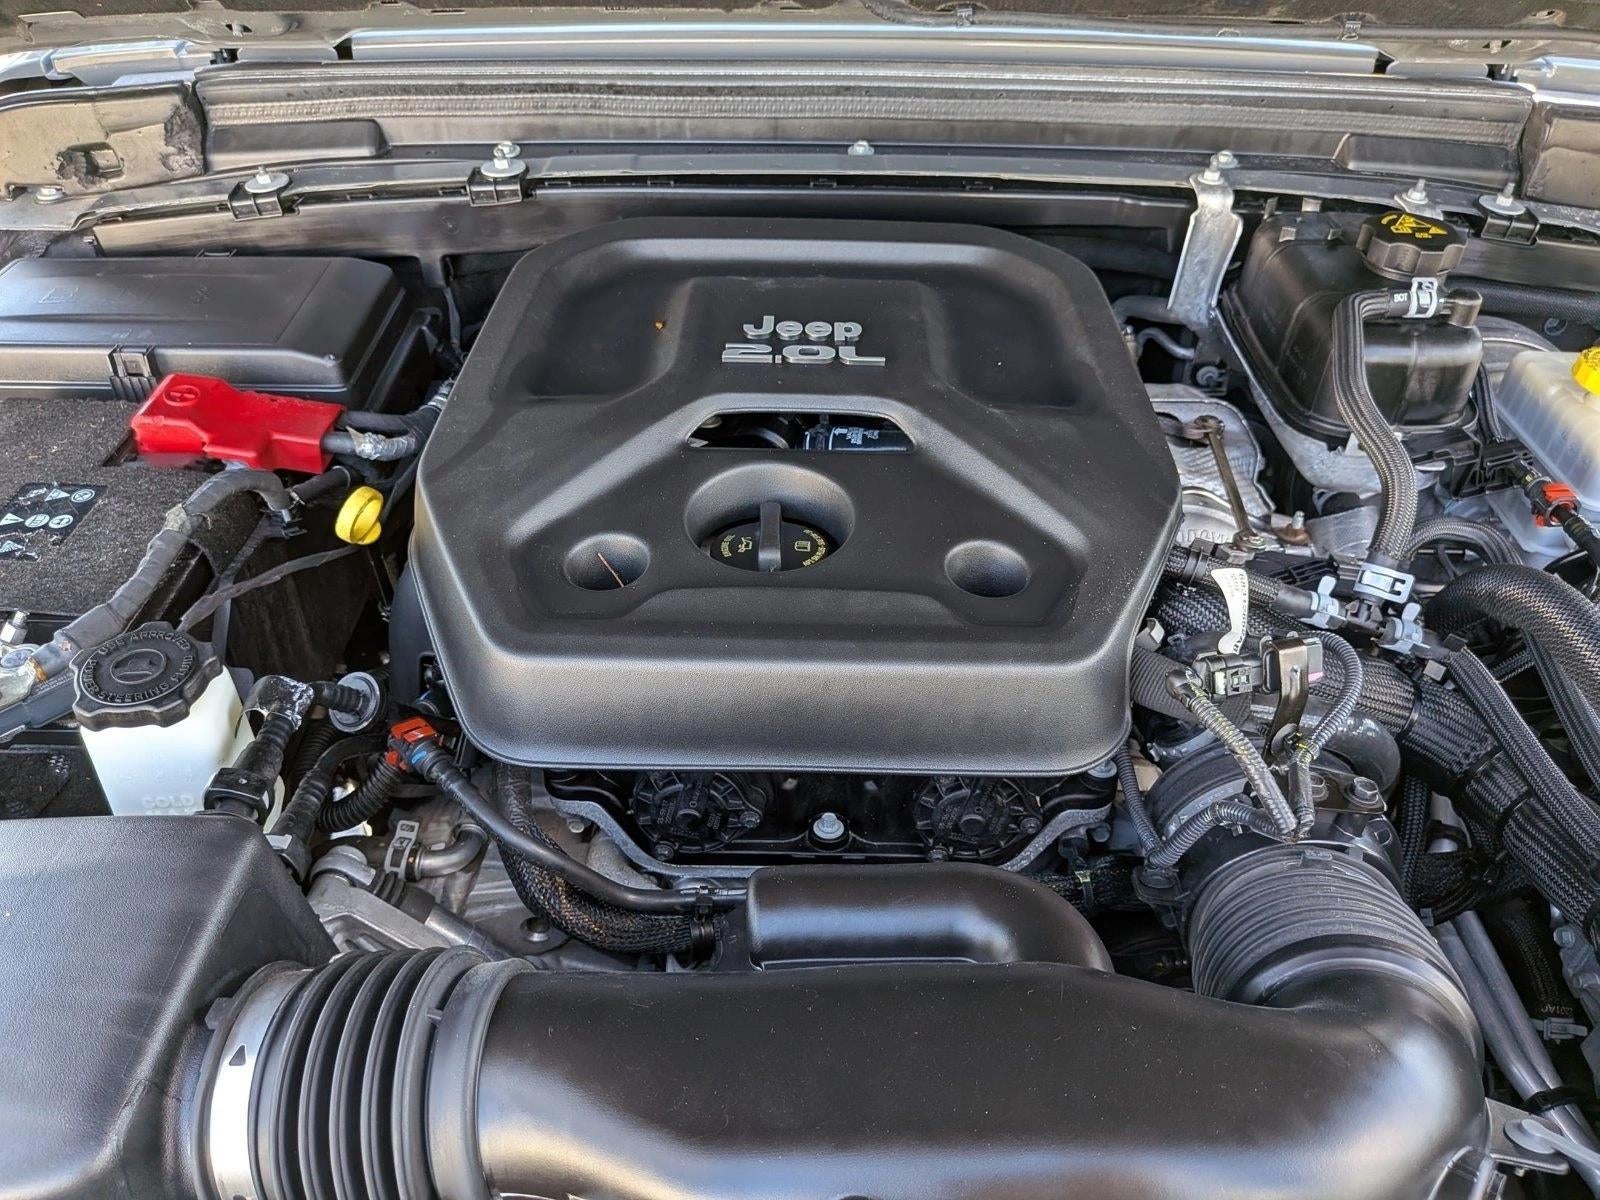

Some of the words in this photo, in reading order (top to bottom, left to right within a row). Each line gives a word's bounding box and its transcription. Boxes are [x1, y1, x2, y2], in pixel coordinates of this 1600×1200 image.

[743, 316, 862, 345] Jeep
[722, 343, 886, 366] 2.0L
[98, 637, 126, 655] USE
[130, 631, 191, 650] APPROVED
[83, 659, 99, 694] POWER
[98, 682, 170, 701] STEERING
[171, 655, 193, 682] FLUID
[142, 795, 194, 809] COLD
